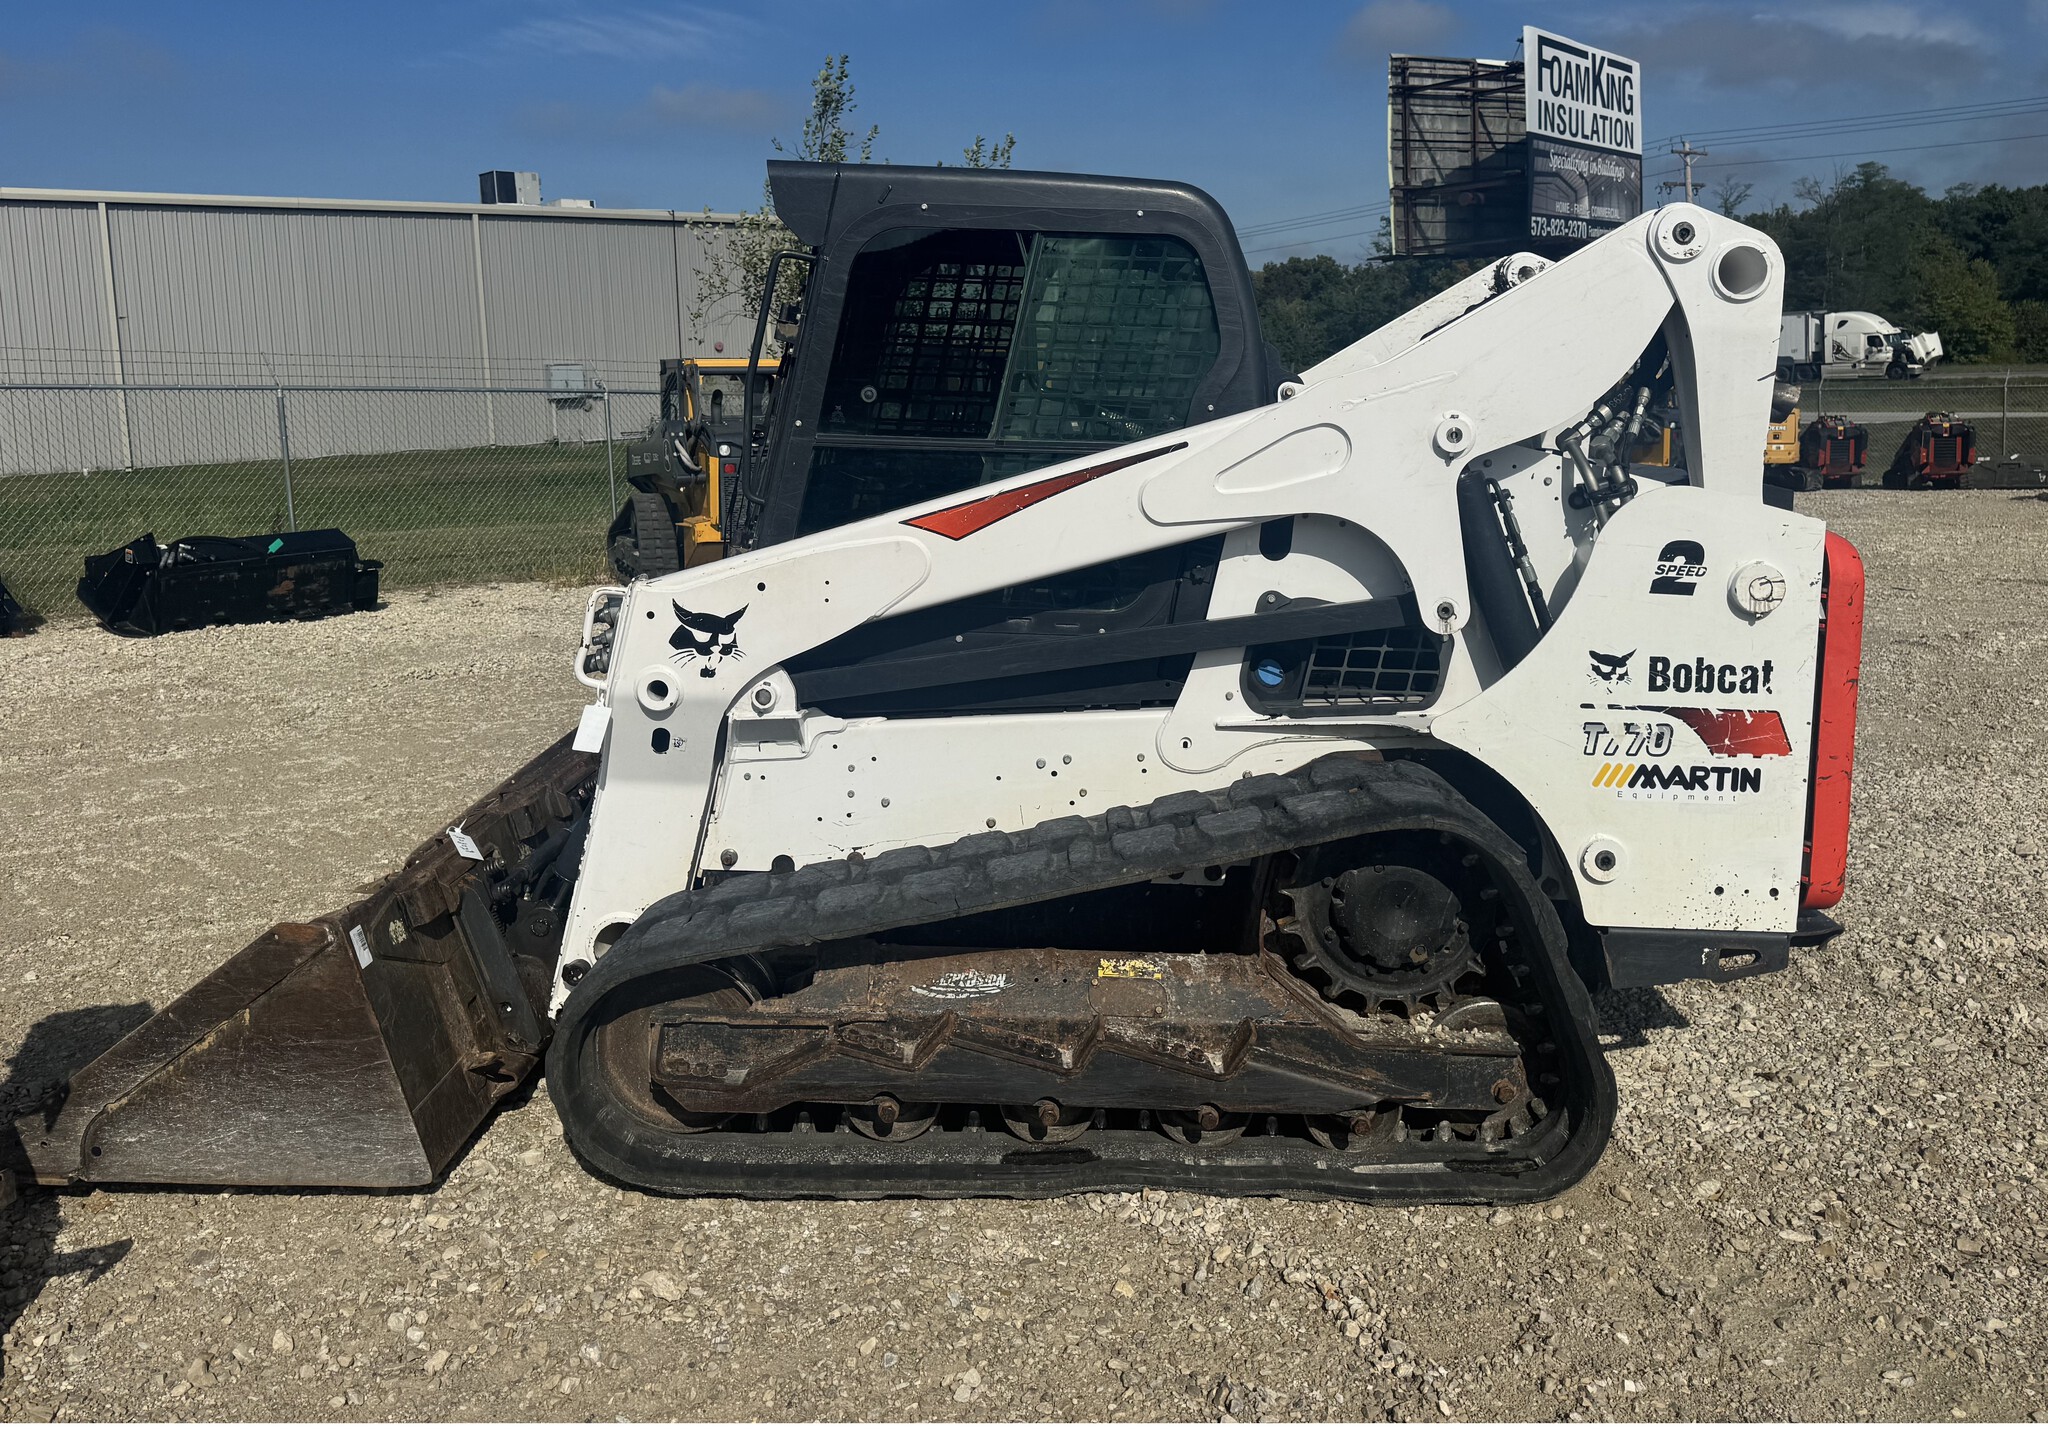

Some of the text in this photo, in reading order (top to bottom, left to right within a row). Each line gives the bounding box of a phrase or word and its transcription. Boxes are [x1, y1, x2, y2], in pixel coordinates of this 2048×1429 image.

[1538, 98, 1633, 149] INSULATION
[1549, 149, 1588, 177] Specializing
[1590, 157, 1597, 174] in
[1555, 201, 1570, 213] HOME
[1531, 216, 1587, 239] 573-823-2370
[1649, 540, 1705, 596] 2
[1654, 564, 1707, 577] SPEED
[1648, 656, 1774, 694] Bobcat
[1628, 763, 1761, 793] MARTIN
[1617, 791, 1736, 803] Equipment
